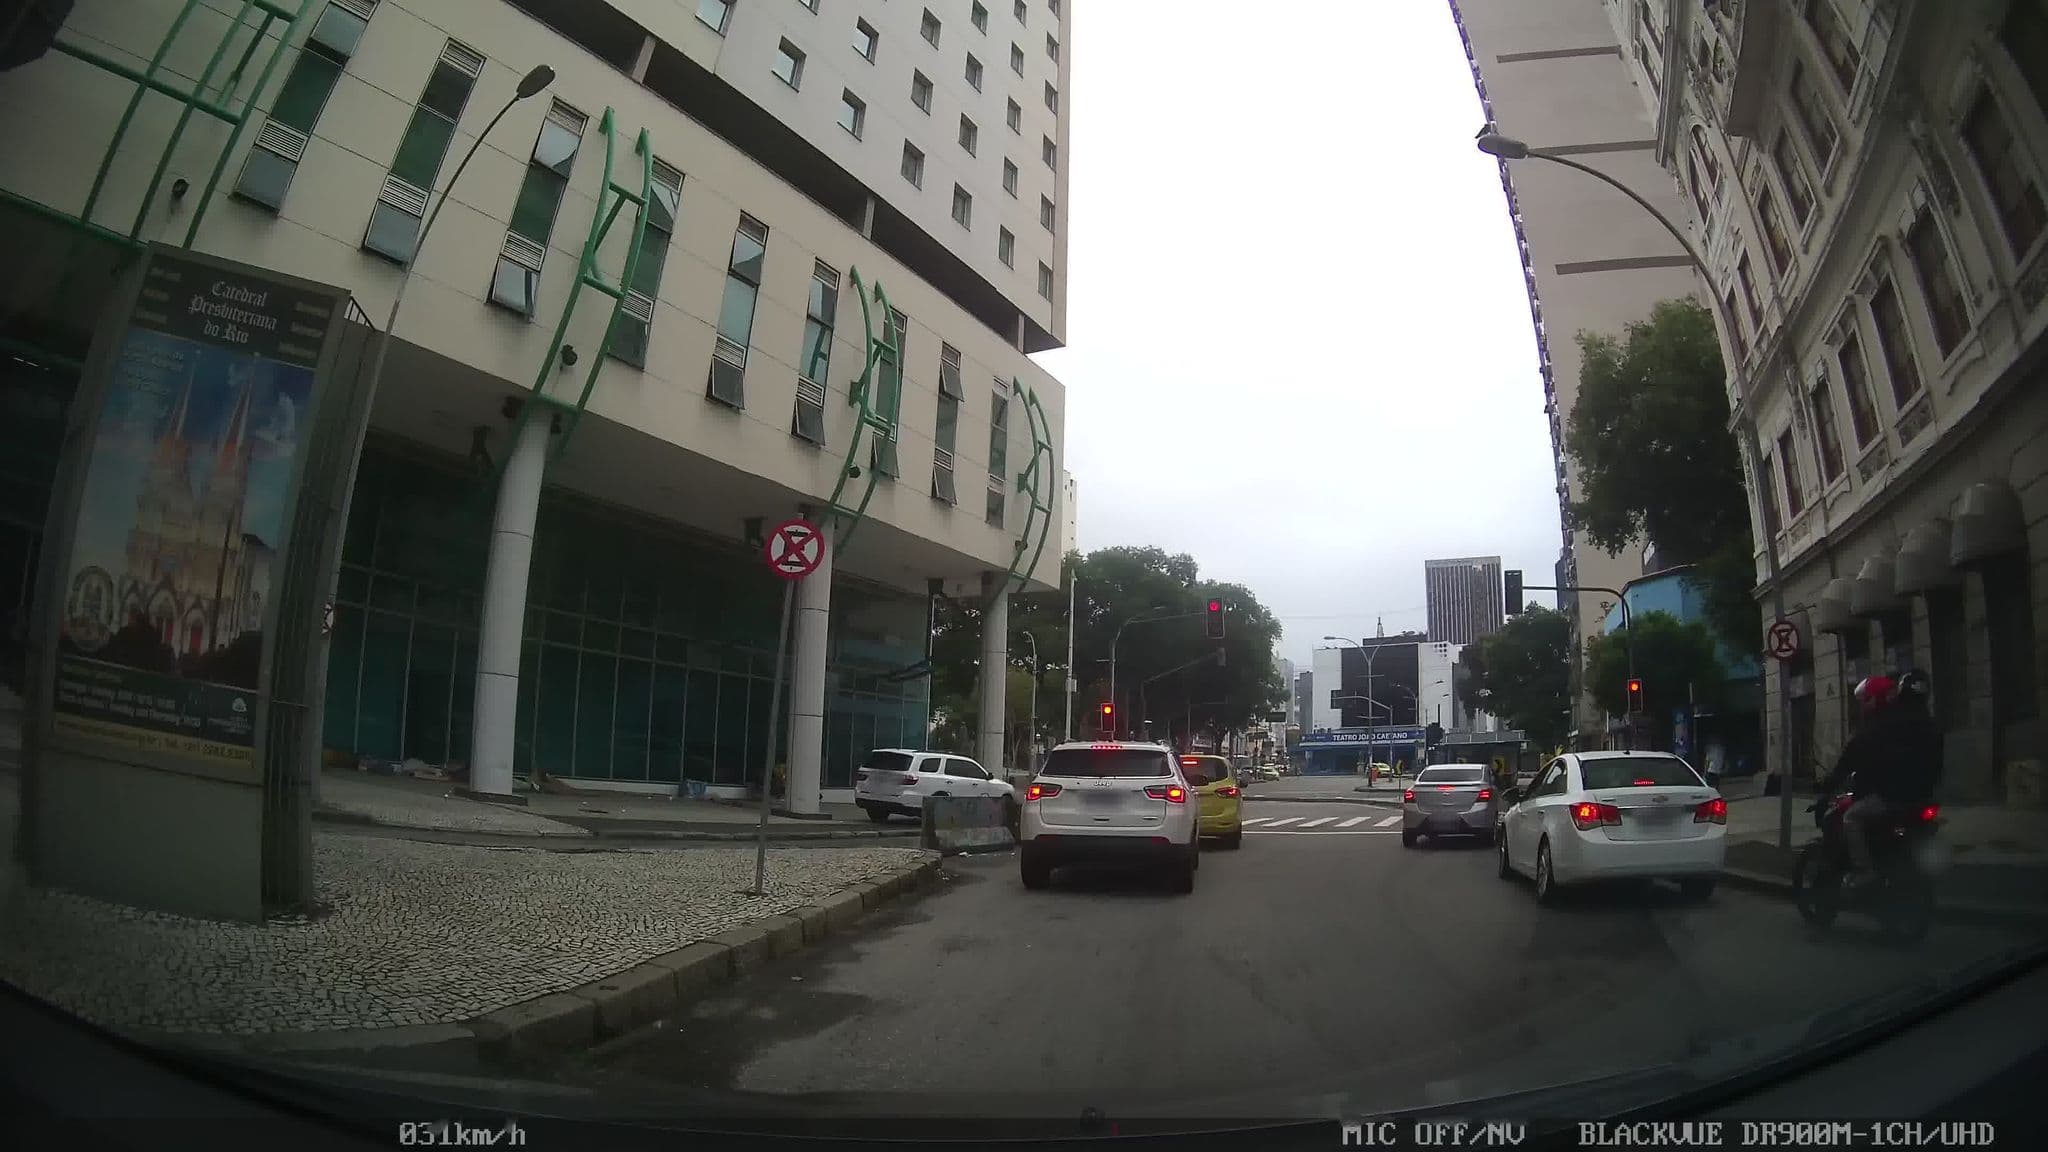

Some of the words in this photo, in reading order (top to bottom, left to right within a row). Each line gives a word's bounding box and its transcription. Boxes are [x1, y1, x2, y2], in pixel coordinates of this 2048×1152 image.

[211, 281, 268, 308] Catedral
[188, 295, 278, 331] Presbiteriana
[203, 319, 219, 337] do
[223, 323, 249, 344] Rio
[1376, 732, 1408, 740] CAEANO
